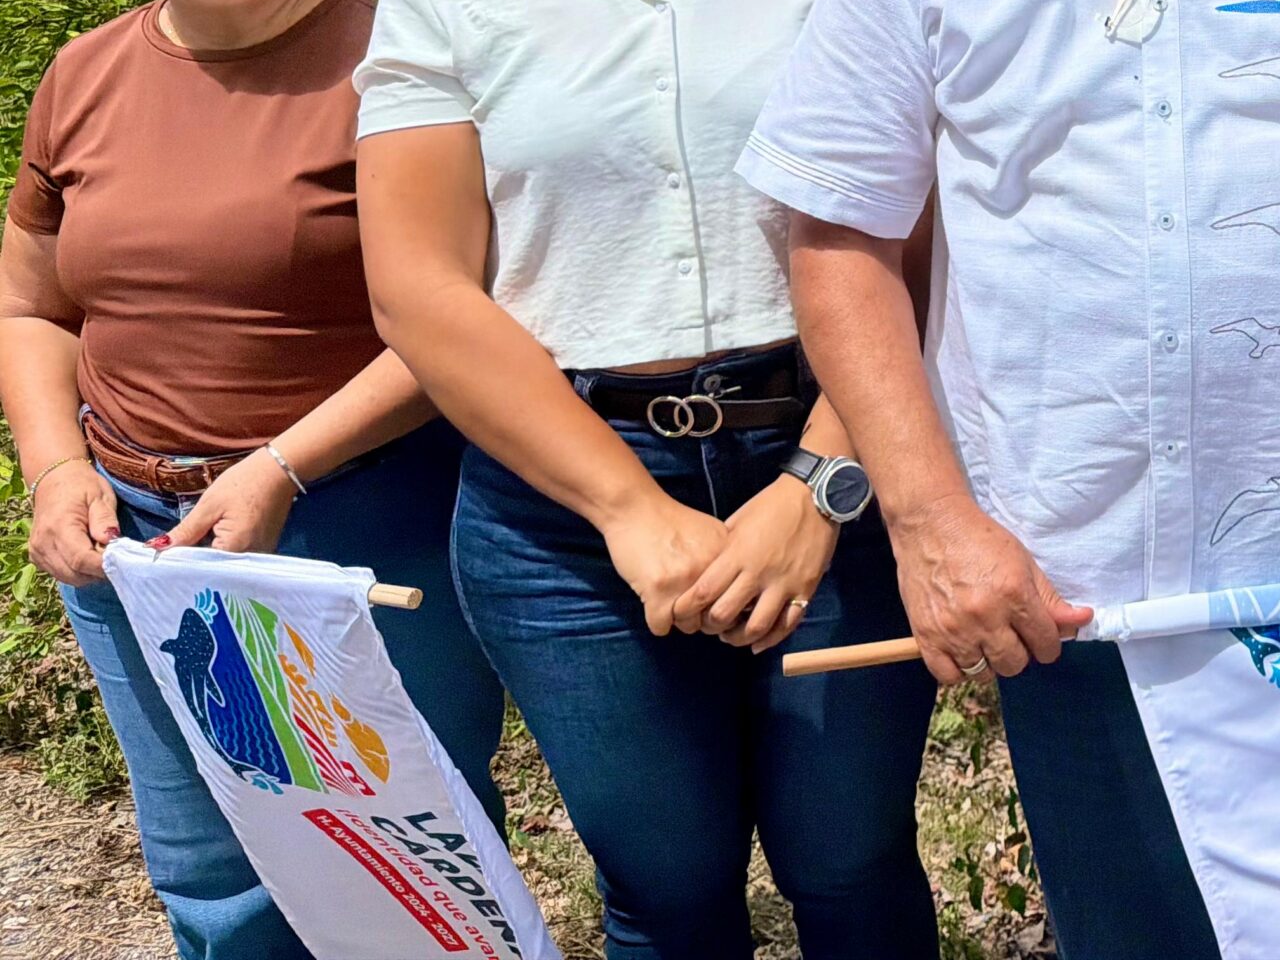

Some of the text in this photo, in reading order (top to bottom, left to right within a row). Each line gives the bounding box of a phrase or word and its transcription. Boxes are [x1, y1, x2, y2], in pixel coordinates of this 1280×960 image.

[331, 826, 405, 893] Ayuntamiento
[402, 894, 431, 917] 2024
[431, 922, 460, 947] 2027
[370, 816, 523, 960] CÁRDEN
[433, 890, 468, 922] que
